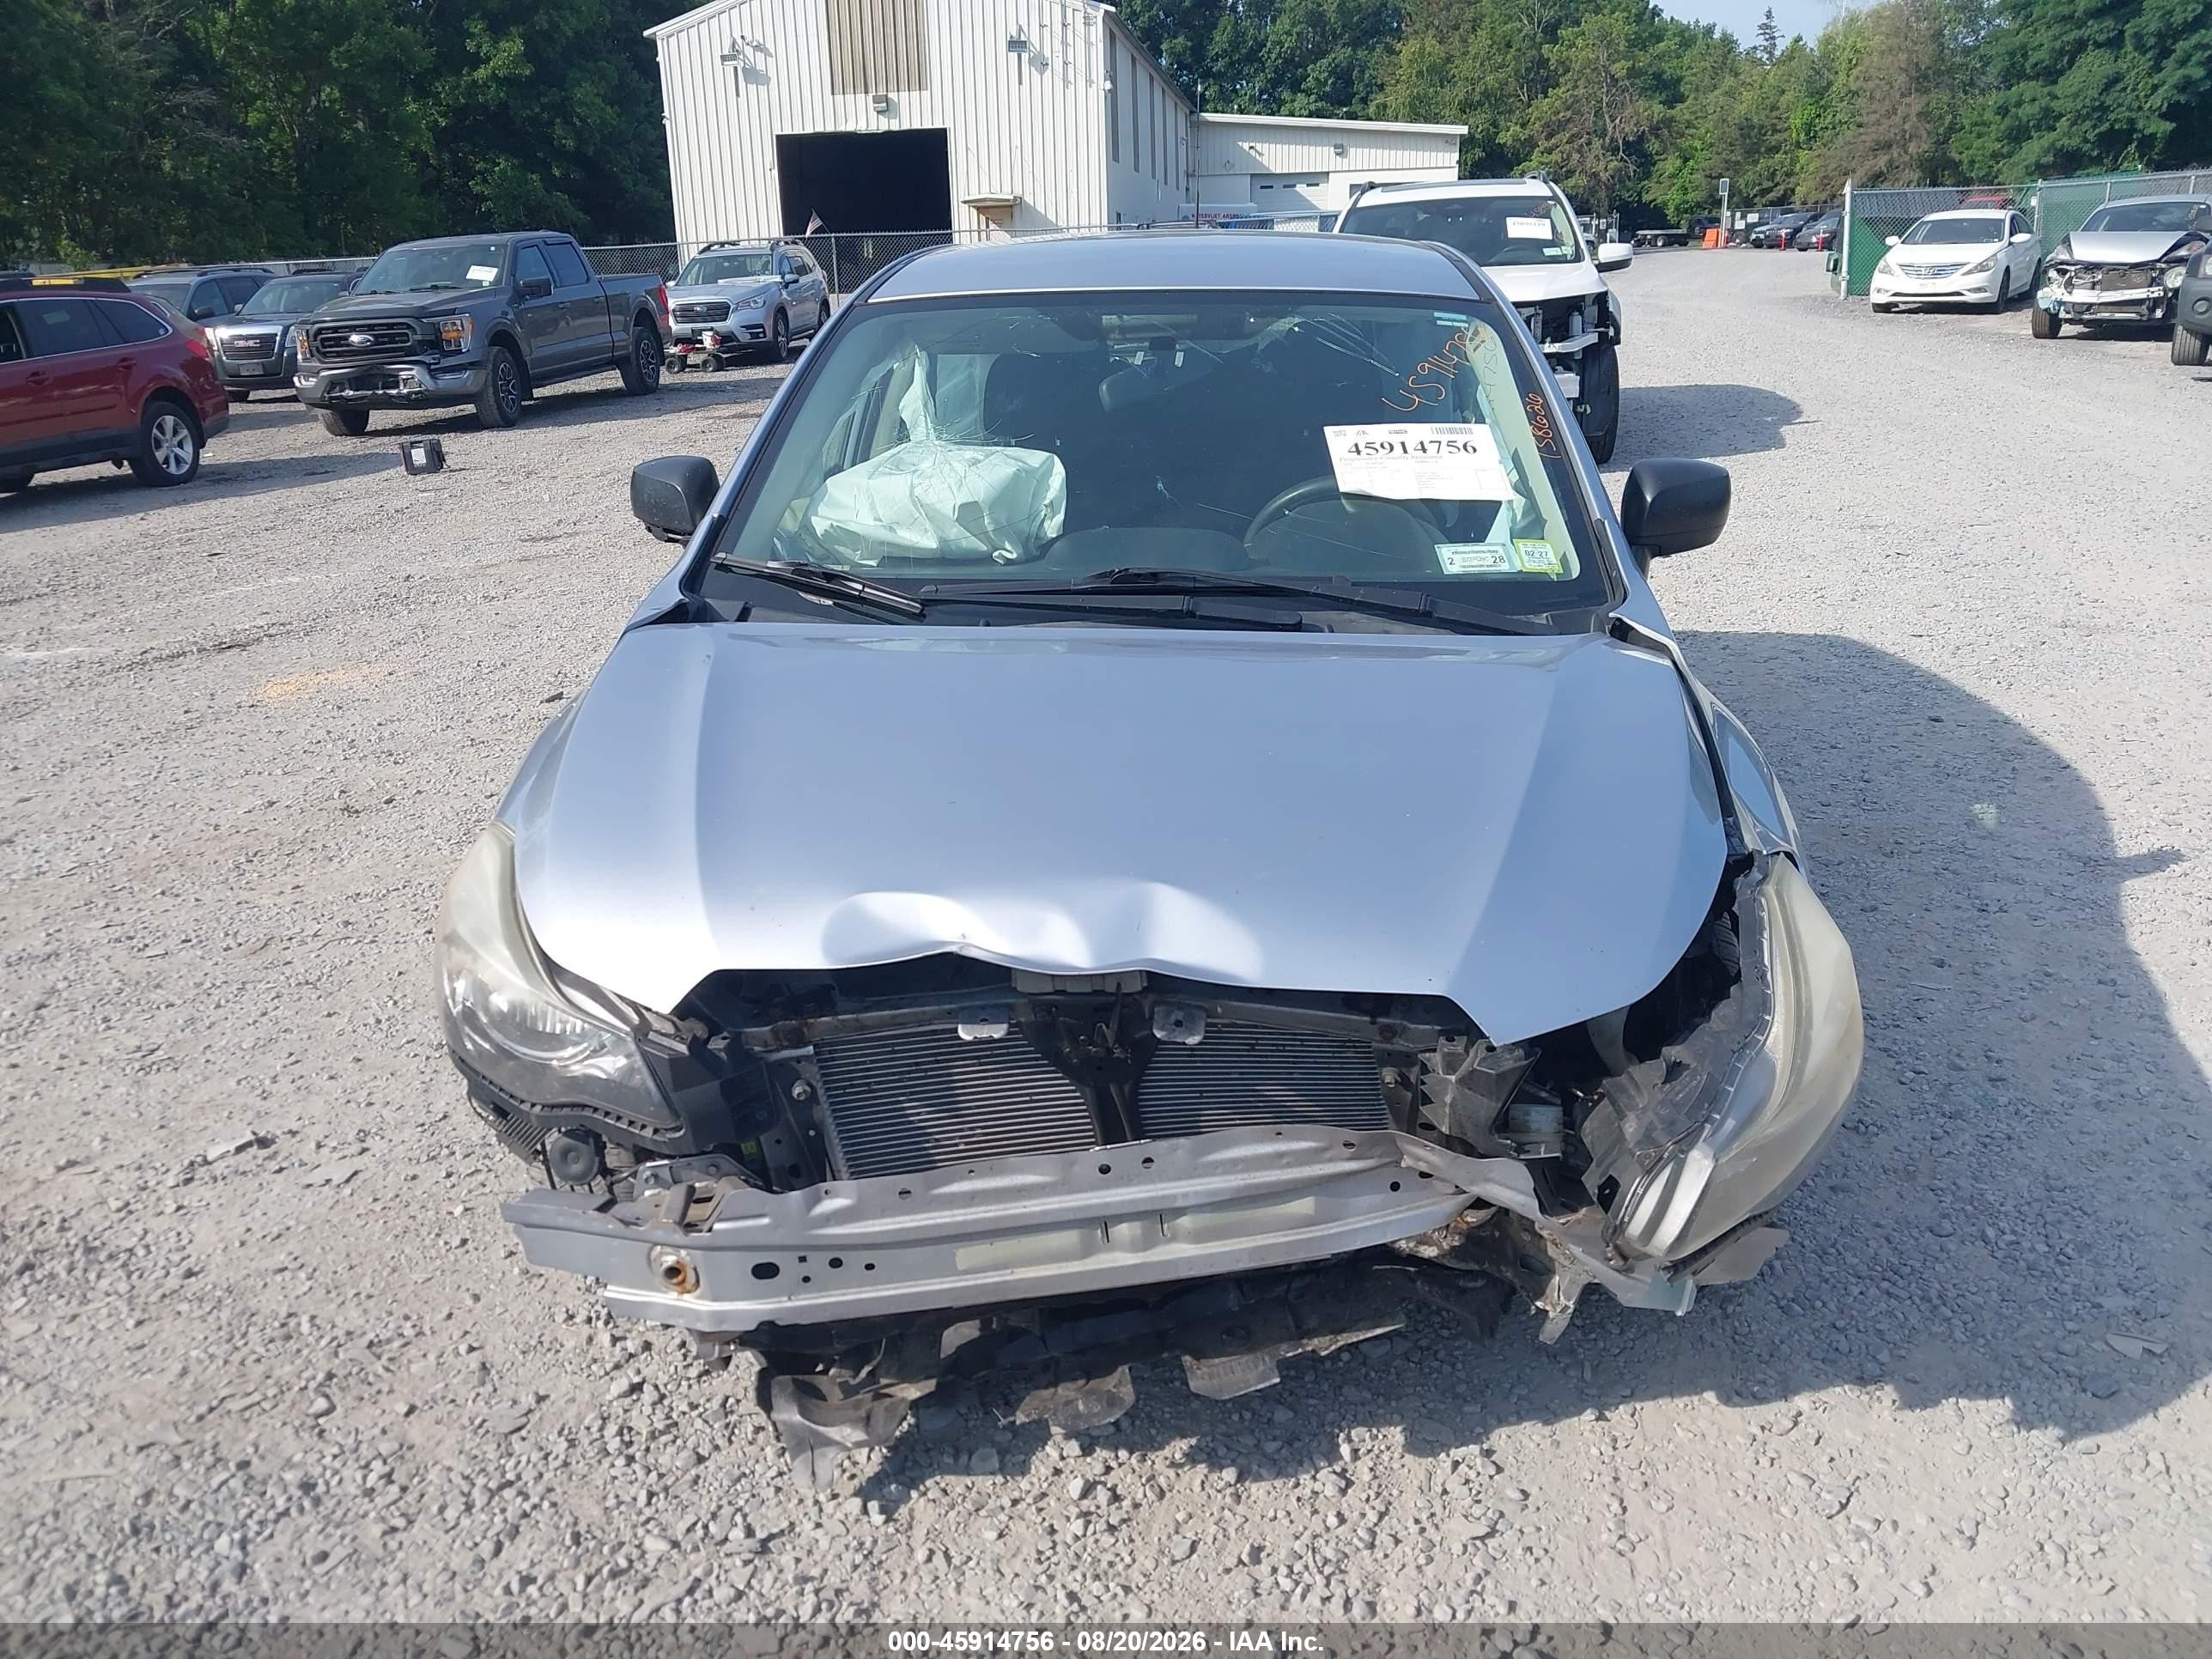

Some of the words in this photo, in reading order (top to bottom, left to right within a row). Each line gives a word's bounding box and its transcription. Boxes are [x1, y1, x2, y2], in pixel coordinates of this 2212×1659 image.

[1347, 440, 1478, 456] 45914756
[1447, 556, 1456, 566] 2
[1491, 555, 1506, 565] 28
